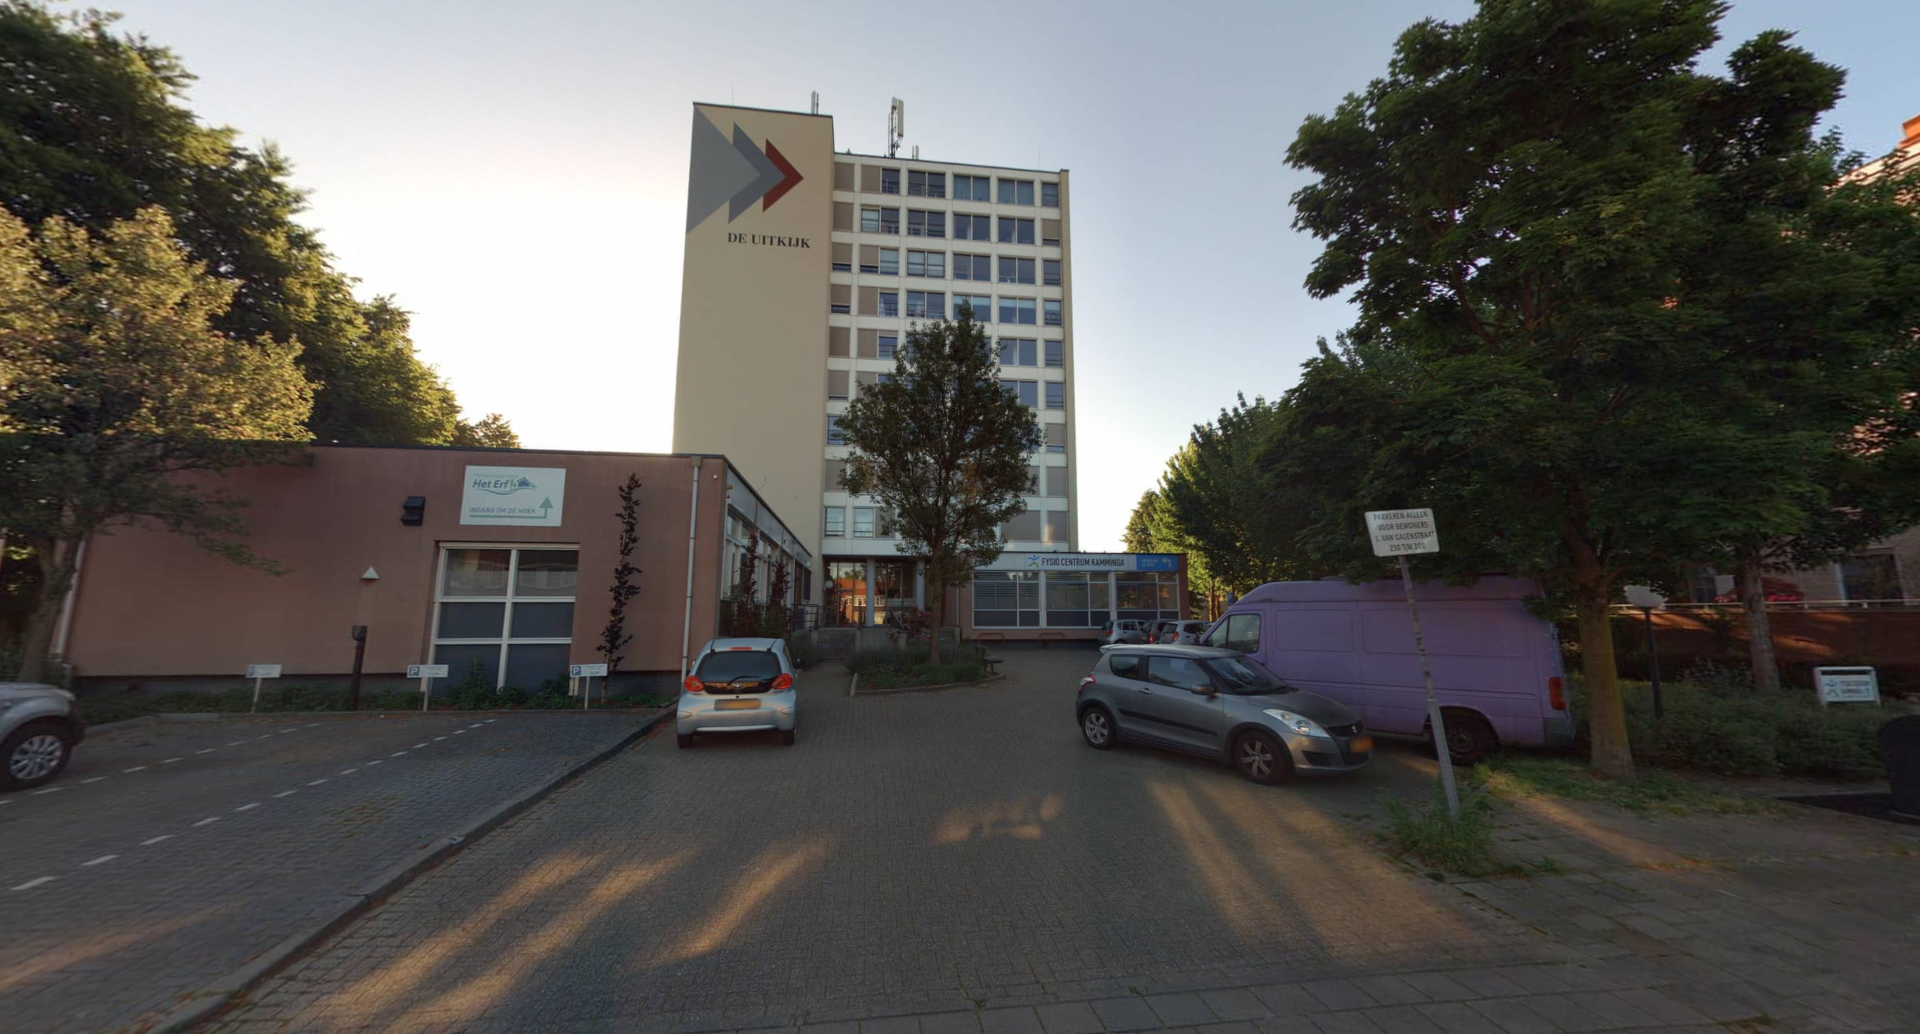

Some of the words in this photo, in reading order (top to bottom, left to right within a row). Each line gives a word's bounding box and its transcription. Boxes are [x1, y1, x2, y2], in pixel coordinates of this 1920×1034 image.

[728, 232, 747, 244] DE
[752, 234, 810, 248] UITKIJK
[472, 478, 491, 488] Het
[494, 479, 509, 488] Erf
[1373, 512, 1404, 520] PARKEREN
[1396, 521, 1428, 530] BEWONERS
[1042, 558, 1060, 566] FYSIO
[1060, 558, 1090, 566] CENTRUM
[1091, 558, 1125, 566] KAMMINGA
